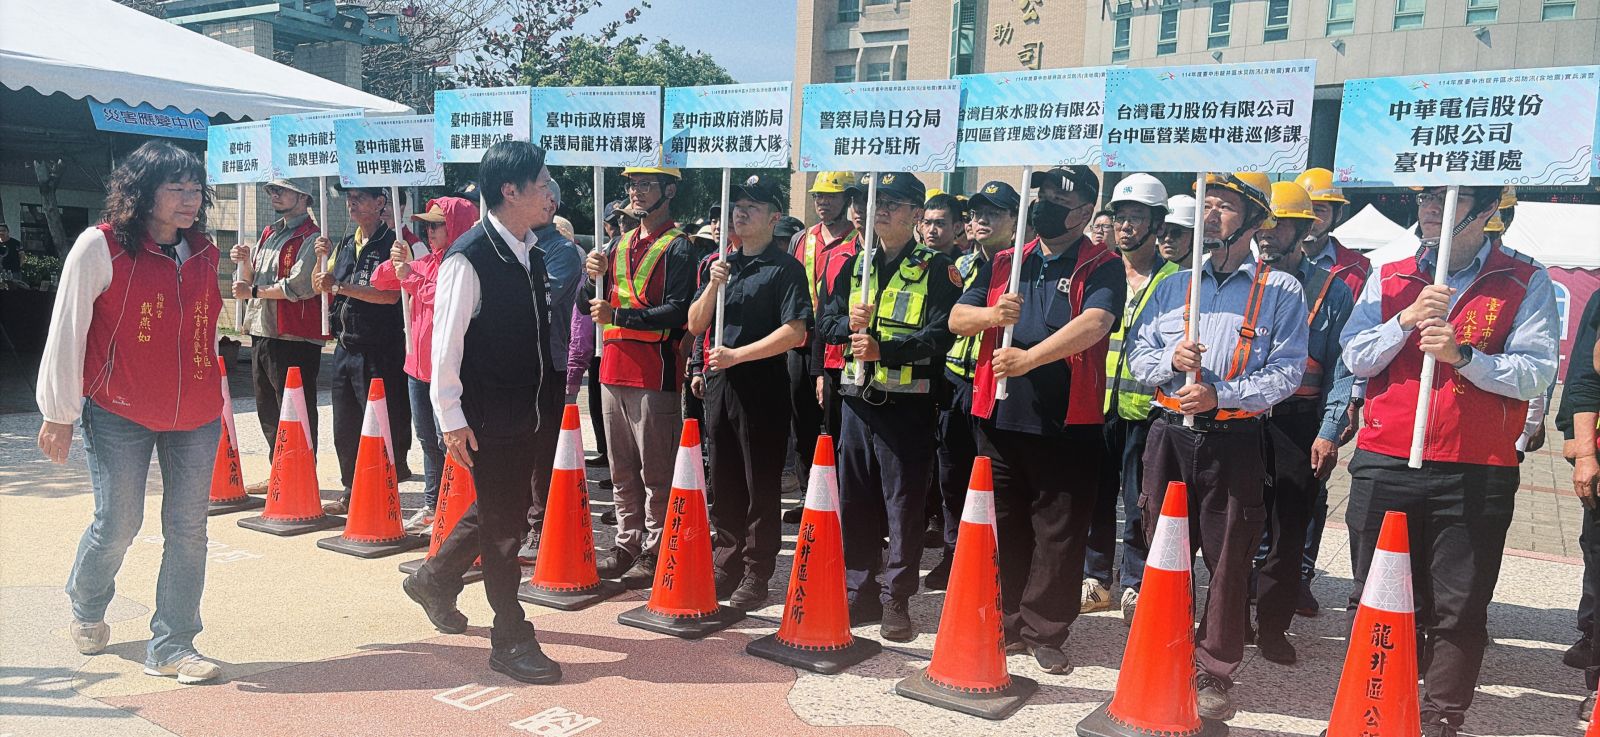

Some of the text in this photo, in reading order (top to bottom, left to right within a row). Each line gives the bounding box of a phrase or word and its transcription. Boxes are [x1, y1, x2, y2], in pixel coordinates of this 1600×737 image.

[958, 101, 1105, 122] 灣自來水股份有限公
[1117, 98, 1295, 121] 台灣電力股份有限公司
[1389, 93, 1544, 121] 中華電信股份
[103, 107, 206, 131] 災害應變中心
[451, 110, 514, 127] 臺中市龍井區
[546, 111, 646, 129] 臺中市政府環境
[672, 108, 783, 130] 臺中市政府消防局
[820, 108, 941, 130] 警察局烏日分局
[539, 134, 653, 153] 保護局龍井清潔隊
[957, 123, 1103, 143] 四區管理處沙鹿營運
[1107, 124, 1302, 145] 台中區營業處中港巡修課
[1410, 122, 1513, 146] 有限公司
[229, 141, 251, 155] 臺中市
[355, 137, 424, 155] 臺中市龍井區
[671, 134, 782, 155] 第四救災救護大隊
[834, 136, 921, 156] 龍井分駐所
[221, 158, 259, 173] 龍井區公所
[288, 150, 339, 166] 龍泉里辦公
[357, 159, 427, 175] 田中里辦公處
[1393, 149, 1524, 173] 臺中營運處
[137, 302, 153, 342] 戴燕如
[271, 429, 288, 501] 龍井區公所
[662, 495, 686, 591] 龍井區公所
[790, 522, 816, 625] 龍井區公所
